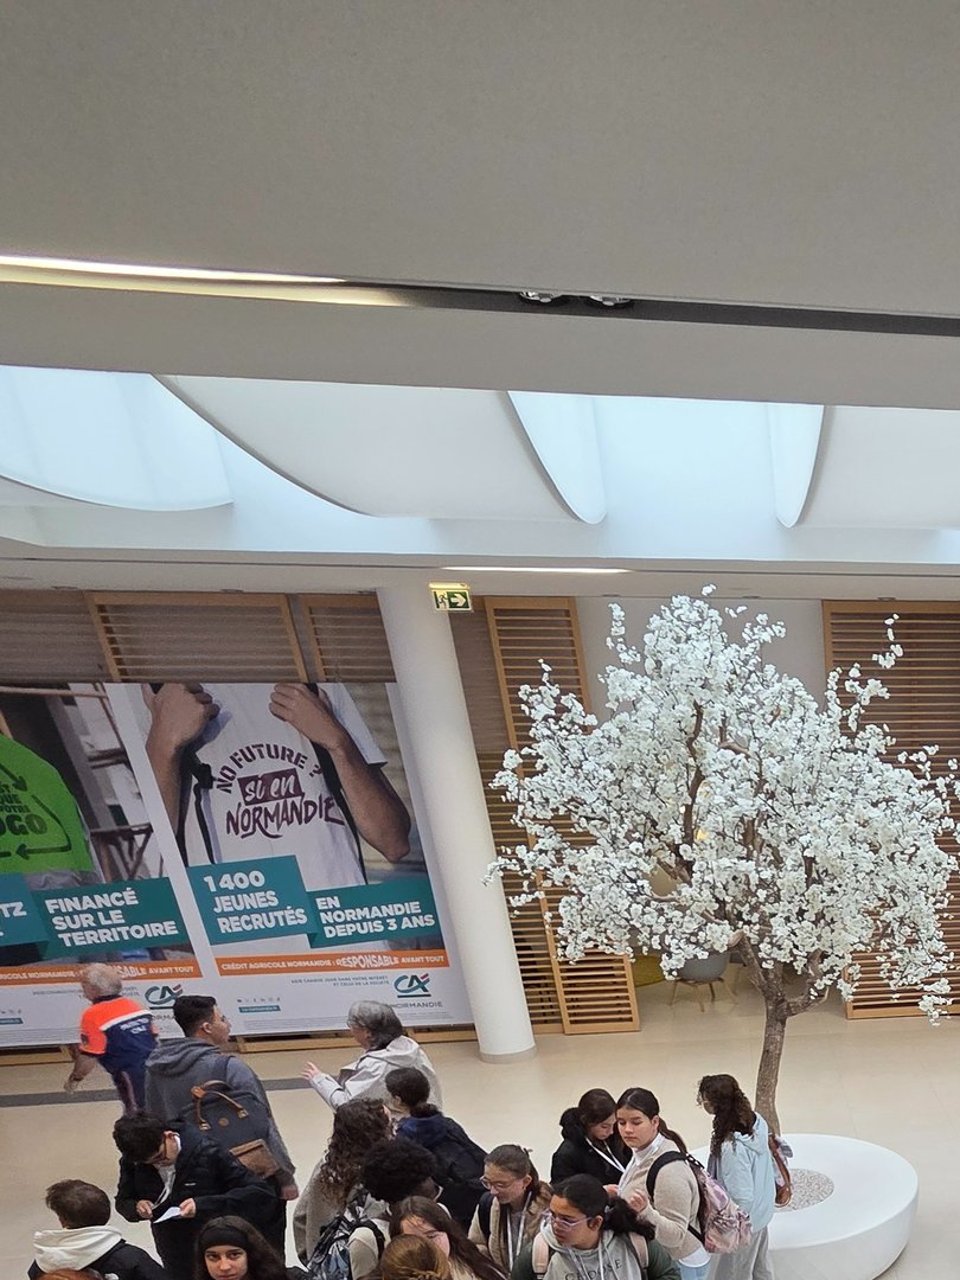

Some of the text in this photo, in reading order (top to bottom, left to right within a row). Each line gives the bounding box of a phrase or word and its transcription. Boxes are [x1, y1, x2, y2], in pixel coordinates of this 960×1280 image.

[216, 765, 237, 794] NO
[230, 743, 308, 769] FUTURE
[244, 774, 296, 802] si en
[226, 793, 345, 839] NORMANDIE
[45, 888, 139, 915] FINANCÉ
[213, 890, 279, 913] JEUNES
[316, 896, 341, 910] EN
[320, 902, 421, 923] NORMANDIE
[52, 910, 125, 931] SUR LE
[217, 907, 307, 933] RECRUTÉS
[325, 915, 435, 938] DEPUIS 3 ANS
[58, 921, 179, 947] TERRITOIRE
[249, 960, 287, 969] AGRICOLE
[287, 959, 332, 968] NORMANDIE
[336, 954, 400, 969] RESPONSABLE
